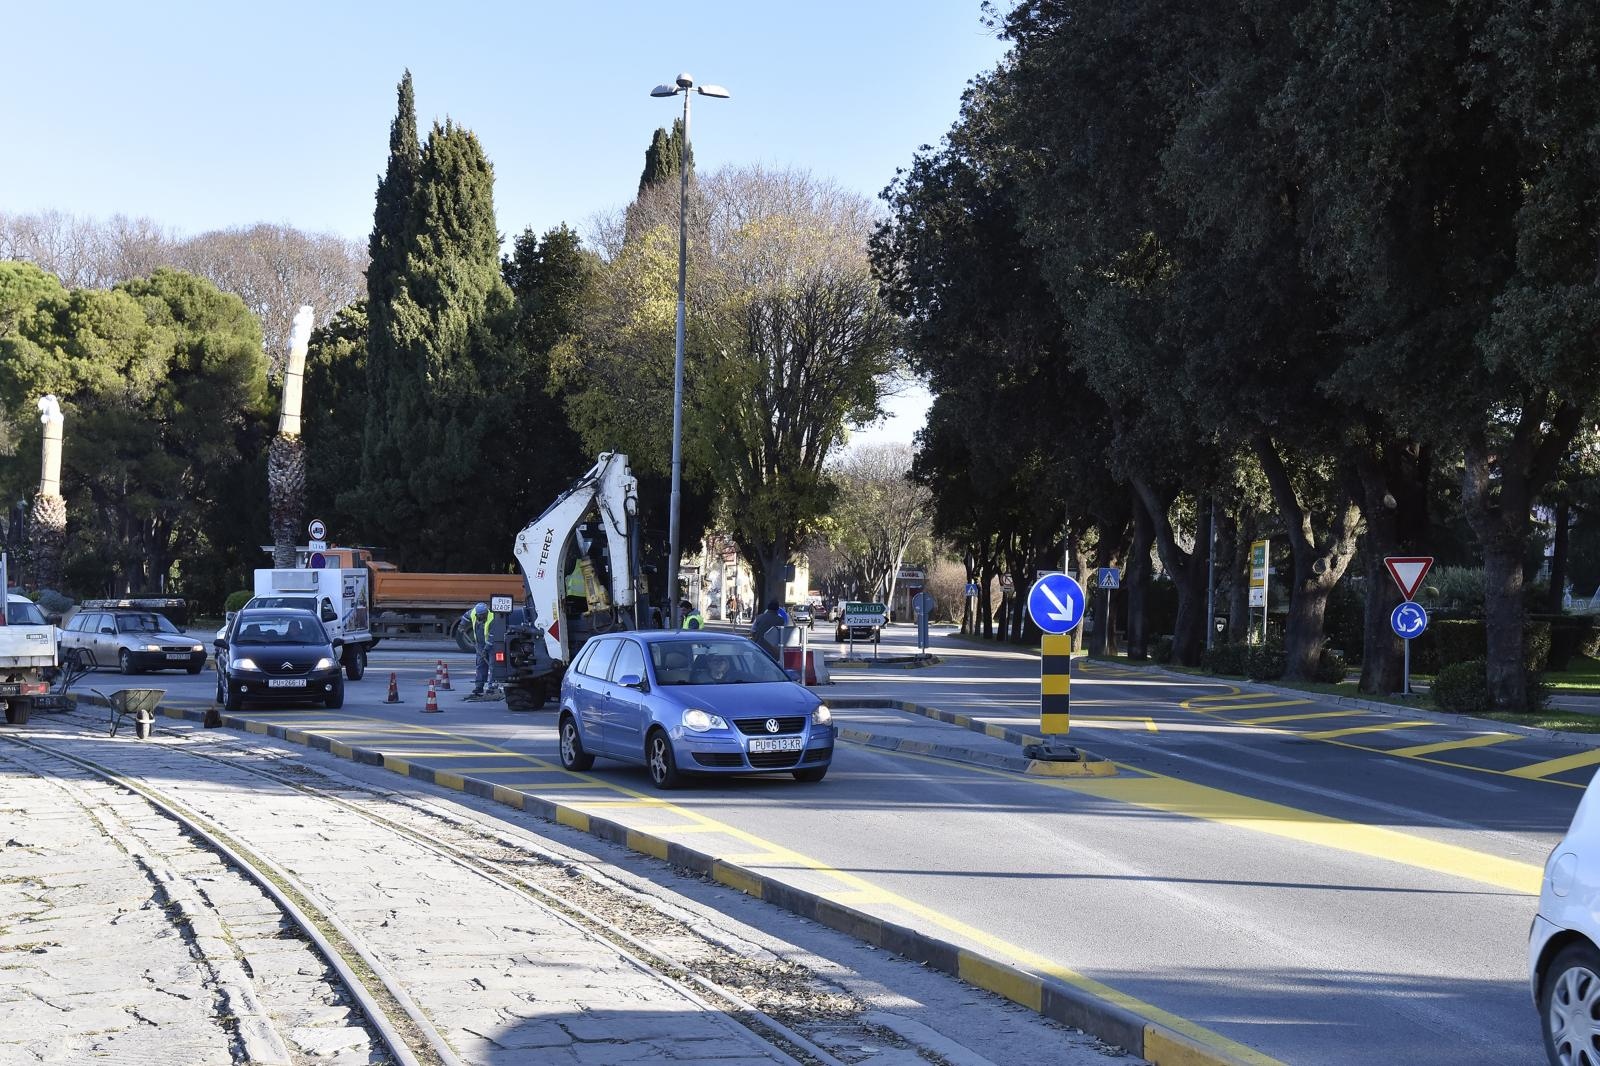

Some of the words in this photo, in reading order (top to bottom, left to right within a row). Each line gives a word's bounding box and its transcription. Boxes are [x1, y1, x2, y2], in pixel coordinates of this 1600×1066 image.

[540, 528, 555, 565] TEREX
[846, 605, 863, 614] Rijeka
[755, 740, 766, 750] PU
[771, 739, 801, 749] 613-KR
